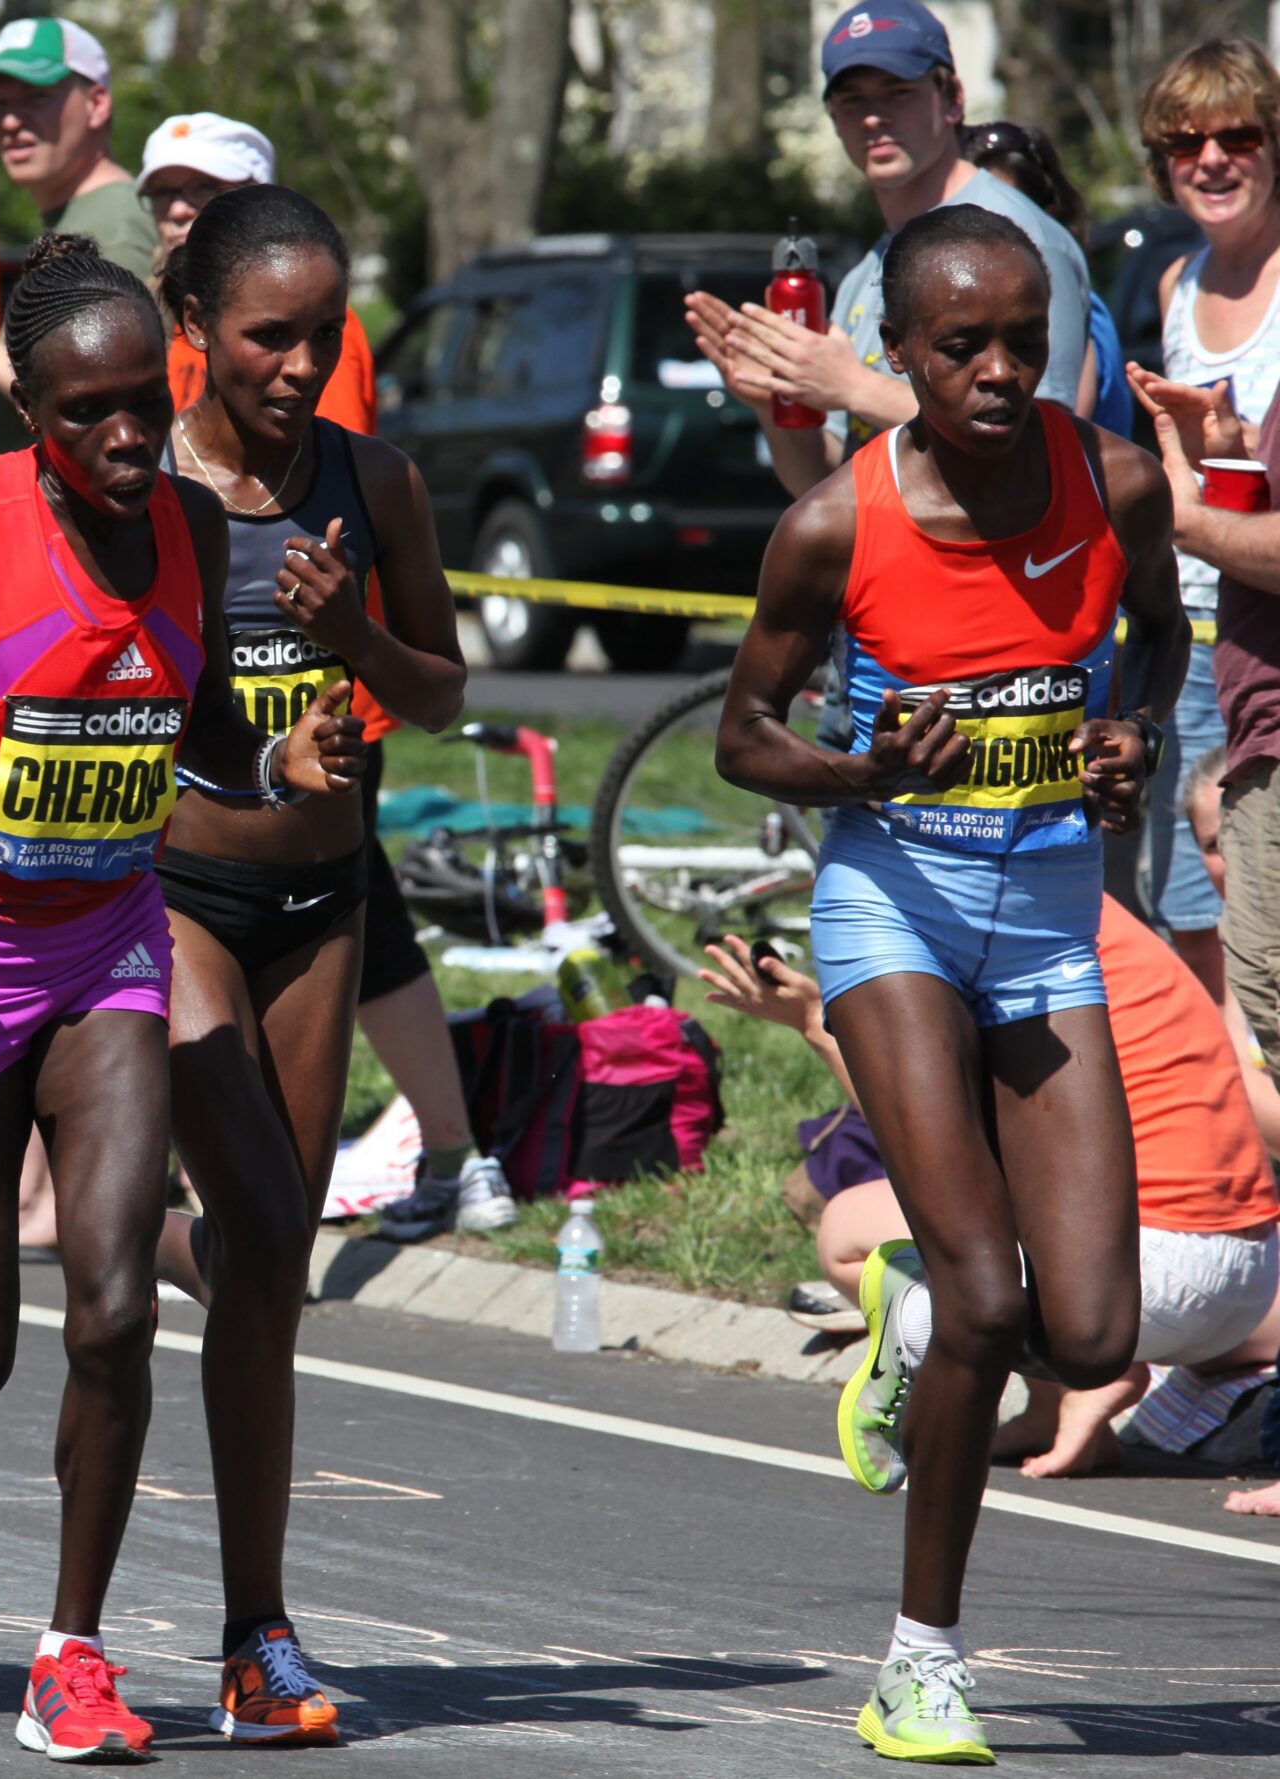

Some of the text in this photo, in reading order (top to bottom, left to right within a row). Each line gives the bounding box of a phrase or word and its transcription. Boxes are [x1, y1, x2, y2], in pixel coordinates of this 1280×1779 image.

[106, 665, 153, 681] adidas
[977, 676, 1083, 708] adidas
[85, 707, 182, 736] adidas
[2, 756, 167, 824] CHEROP
[920, 812, 948, 823] 2012
[952, 812, 1004, 826] BOSTON
[919, 823, 1004, 839] MARATHON
[20, 844, 44, 855] 2012
[48, 843, 96, 855] BOSTON
[17, 854, 94, 868] MARATHON
[111, 965, 161, 979] adidas
